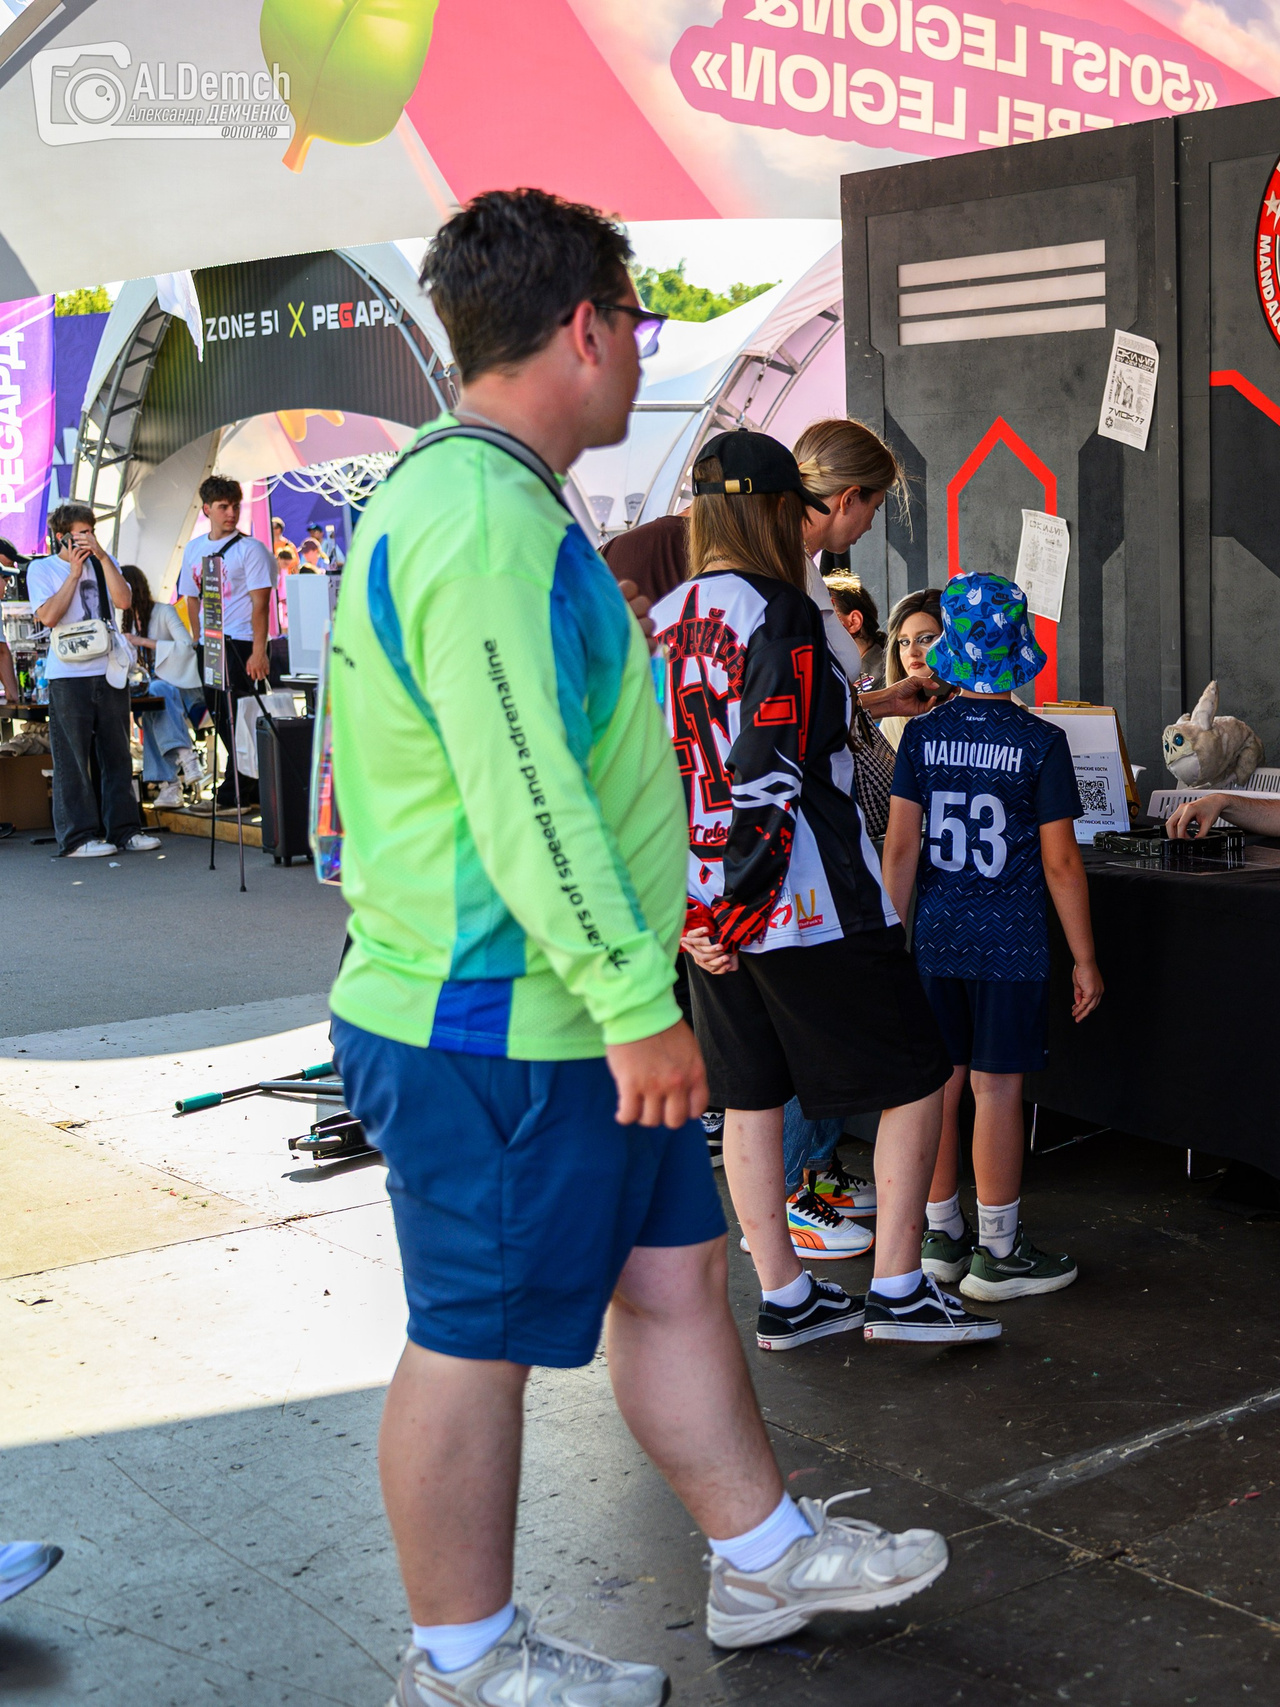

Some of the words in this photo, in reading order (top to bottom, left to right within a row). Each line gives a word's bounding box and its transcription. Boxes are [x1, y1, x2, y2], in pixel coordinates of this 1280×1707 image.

[205, 312, 256, 342] ZONE
[483, 638, 531, 760] adrenaline
[520, 765, 546, 808] and
[534, 812, 573, 880] speed
[929, 790, 1008, 879] 53
[560, 883, 585, 906] of
[577, 909, 612, 951] ars
